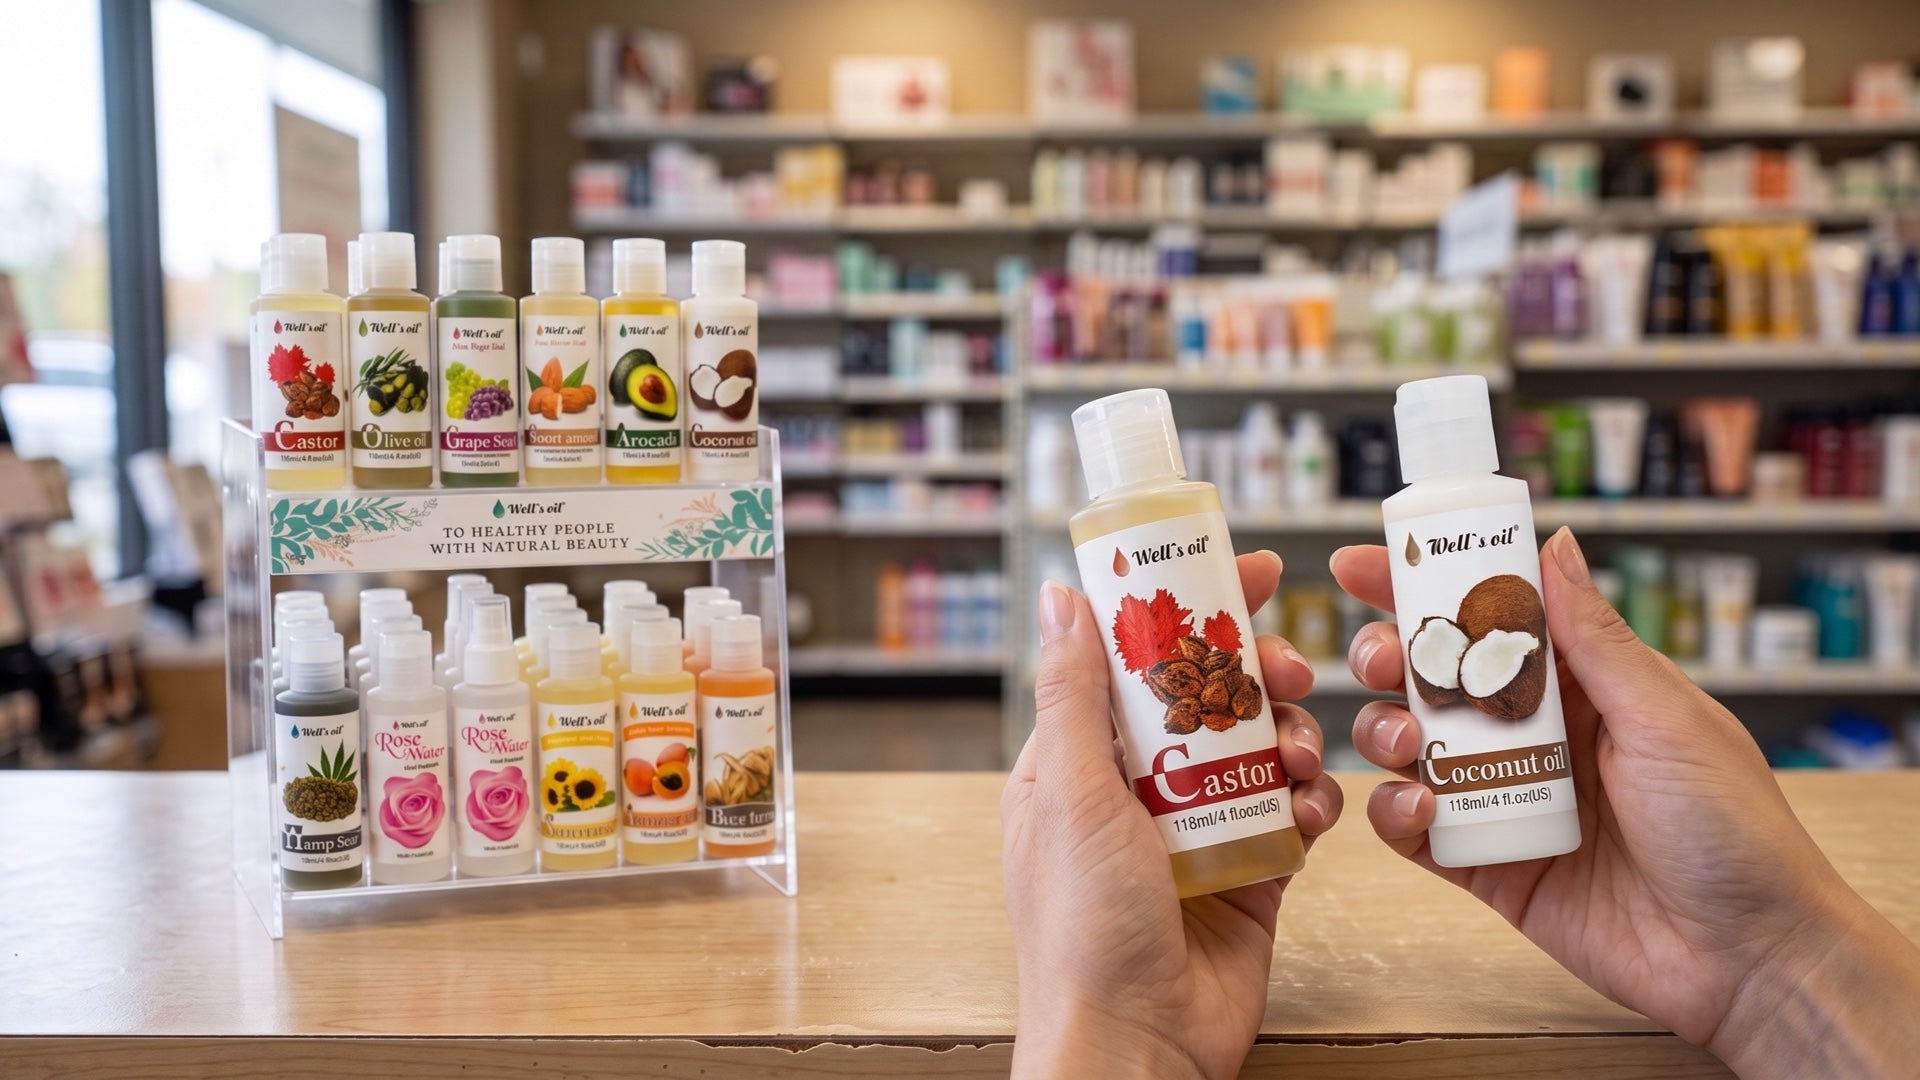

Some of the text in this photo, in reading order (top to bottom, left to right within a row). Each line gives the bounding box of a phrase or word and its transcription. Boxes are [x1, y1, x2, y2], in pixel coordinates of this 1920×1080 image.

[274, 420, 338, 450] Castor
[361, 423, 427, 449] Olive oil
[446, 425, 491, 451] Grape
[691, 423, 745, 447] Coconut
[443, 523, 615, 539] TO HEALTHY PEOPLE
[430, 537, 629, 554] WITH NATURAL BEAUTY
[375, 732, 421, 760] Rose
[461, 726, 508, 754] Rose
[491, 739, 529, 754] Water
[404, 746, 445, 761] Water
[1425, 740, 1566, 786] Coconut oil
[1152, 742, 1275, 804] Castor
[1450, 786, 1552, 812] 118ml/4 fl.oz(US)
[1173, 809, 1227, 832] 118ml/4
